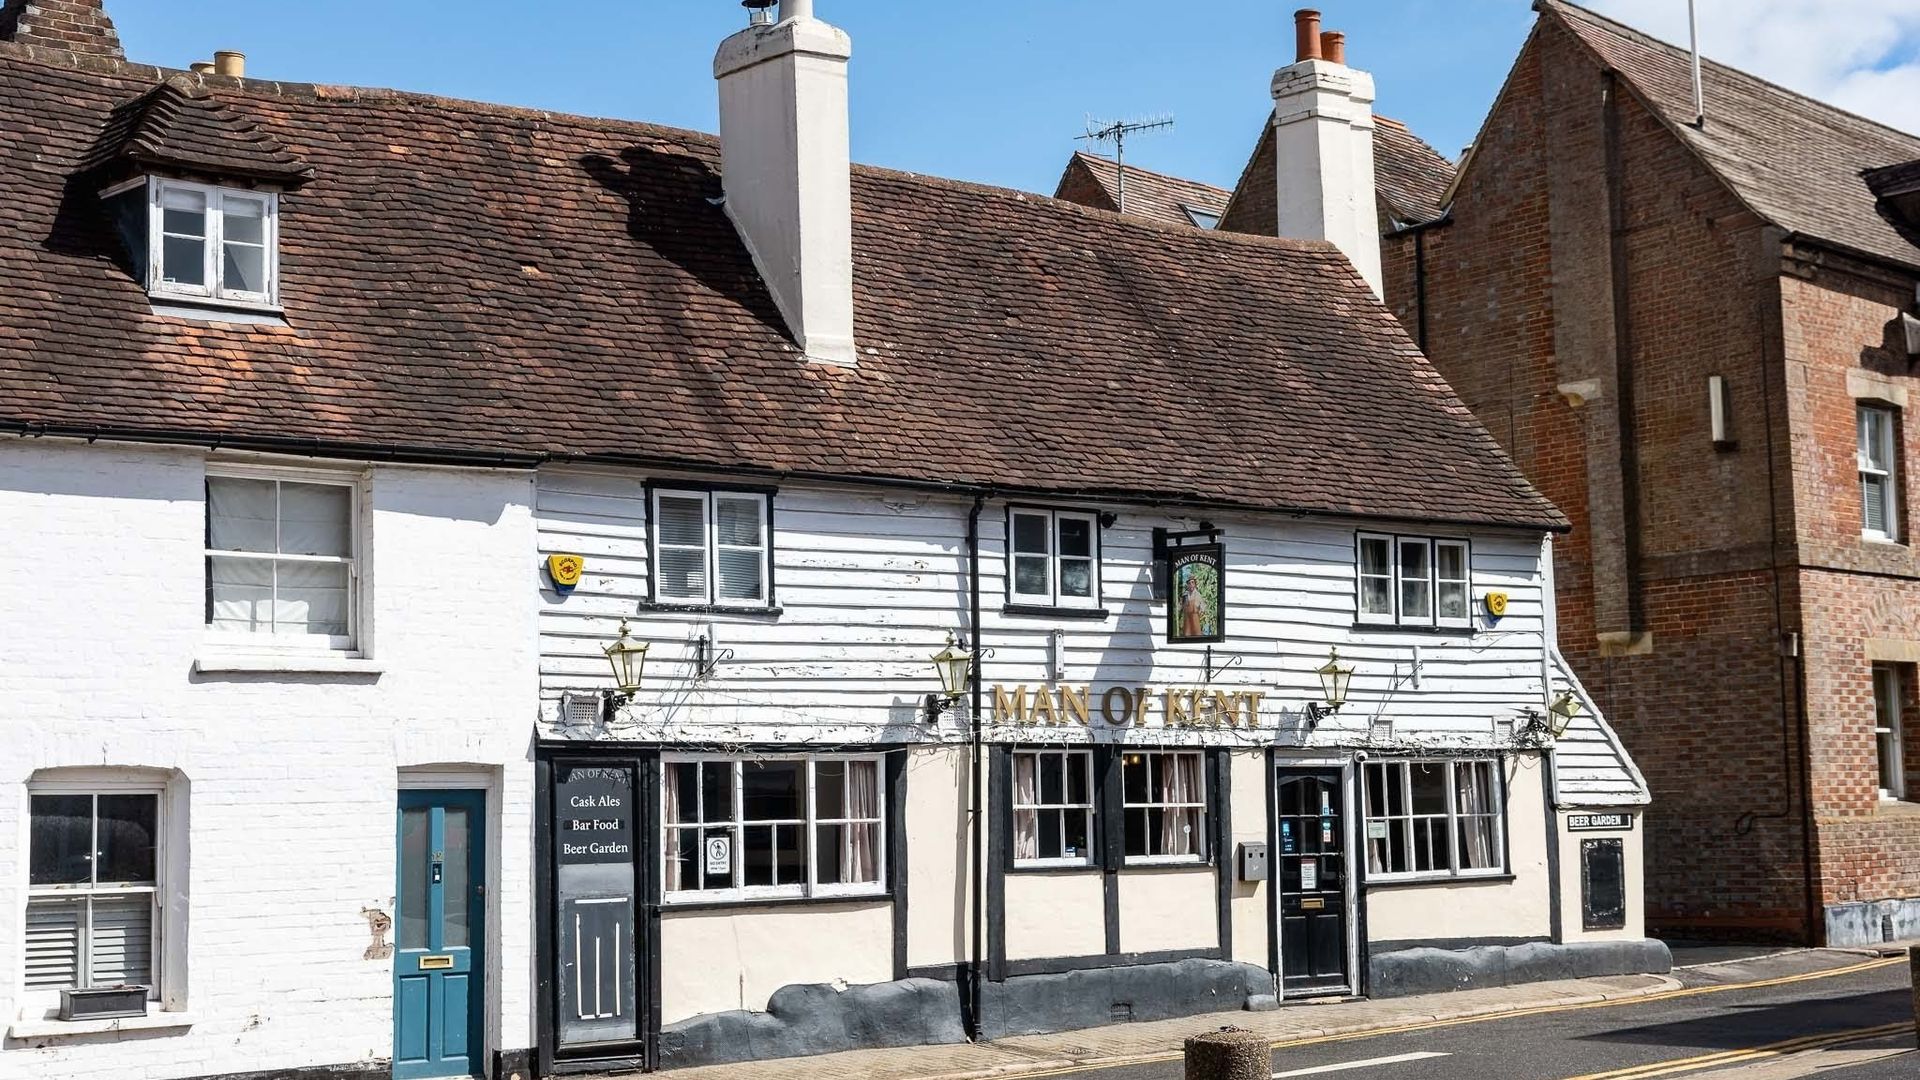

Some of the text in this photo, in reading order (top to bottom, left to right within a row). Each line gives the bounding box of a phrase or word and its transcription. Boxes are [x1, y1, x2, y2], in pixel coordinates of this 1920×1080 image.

[1175, 553, 1217, 569] MAN OF KENT
[990, 683, 1266, 728] MAN OF KENT
[587, 769, 600, 779] OF
[570, 795, 621, 807] Cask Ales
[572, 818, 619, 831] Bar Food
[1569, 815, 1621, 827] BEER GARDEN
[563, 841, 629, 855] Beer Garden
